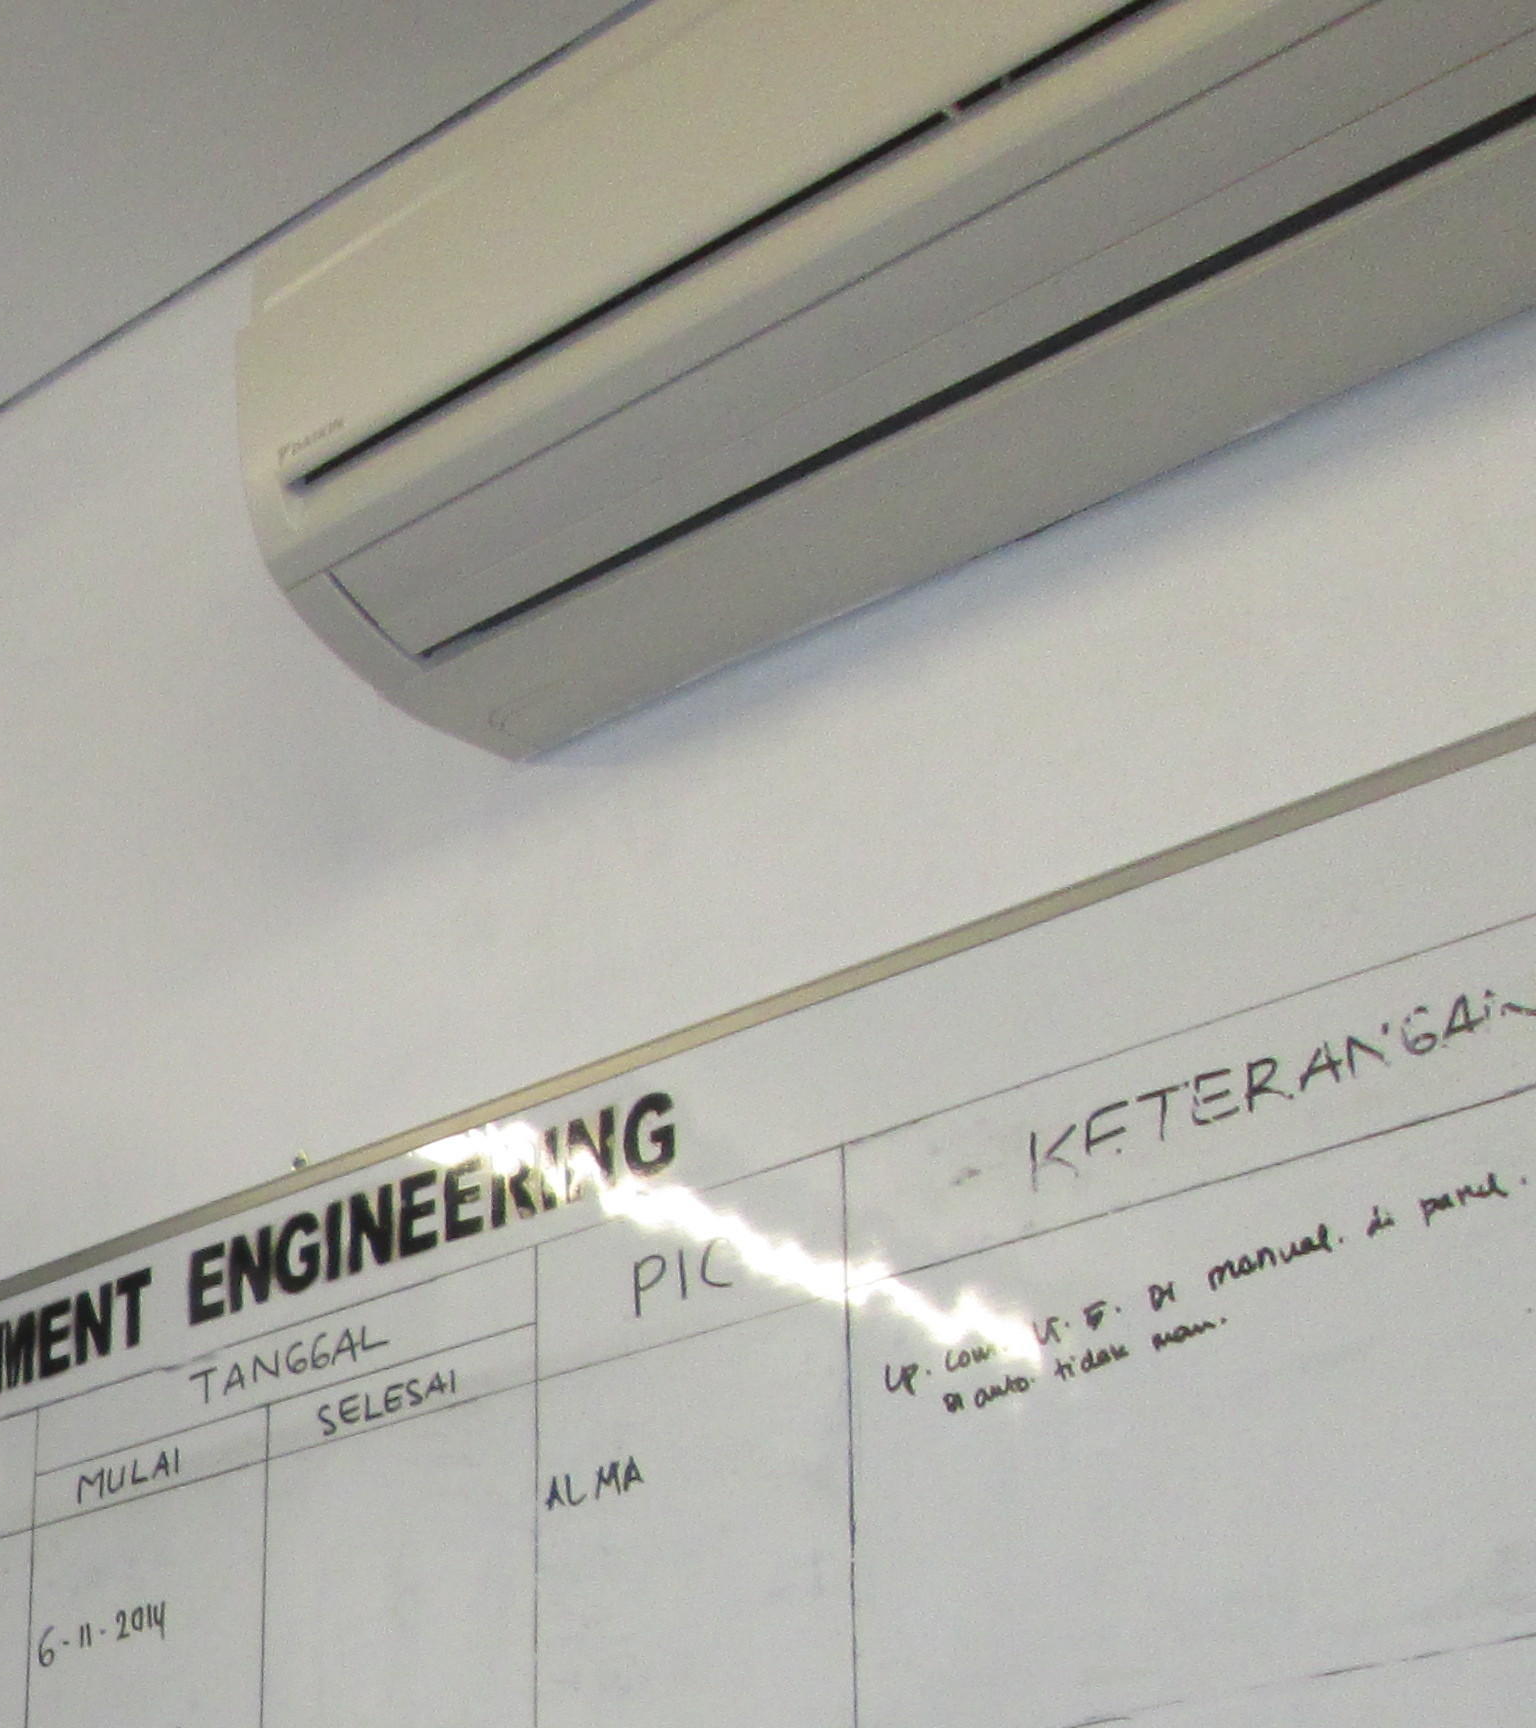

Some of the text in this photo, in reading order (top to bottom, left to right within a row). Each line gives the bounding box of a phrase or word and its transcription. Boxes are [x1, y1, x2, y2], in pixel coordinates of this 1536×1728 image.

[187, 1090, 676, 1326] ENGINEERING
[633, 1237, 732, 1318] PIC
[316, 1367, 458, 1436] SELESAI
[77, 1447, 182, 1507] MULAI
